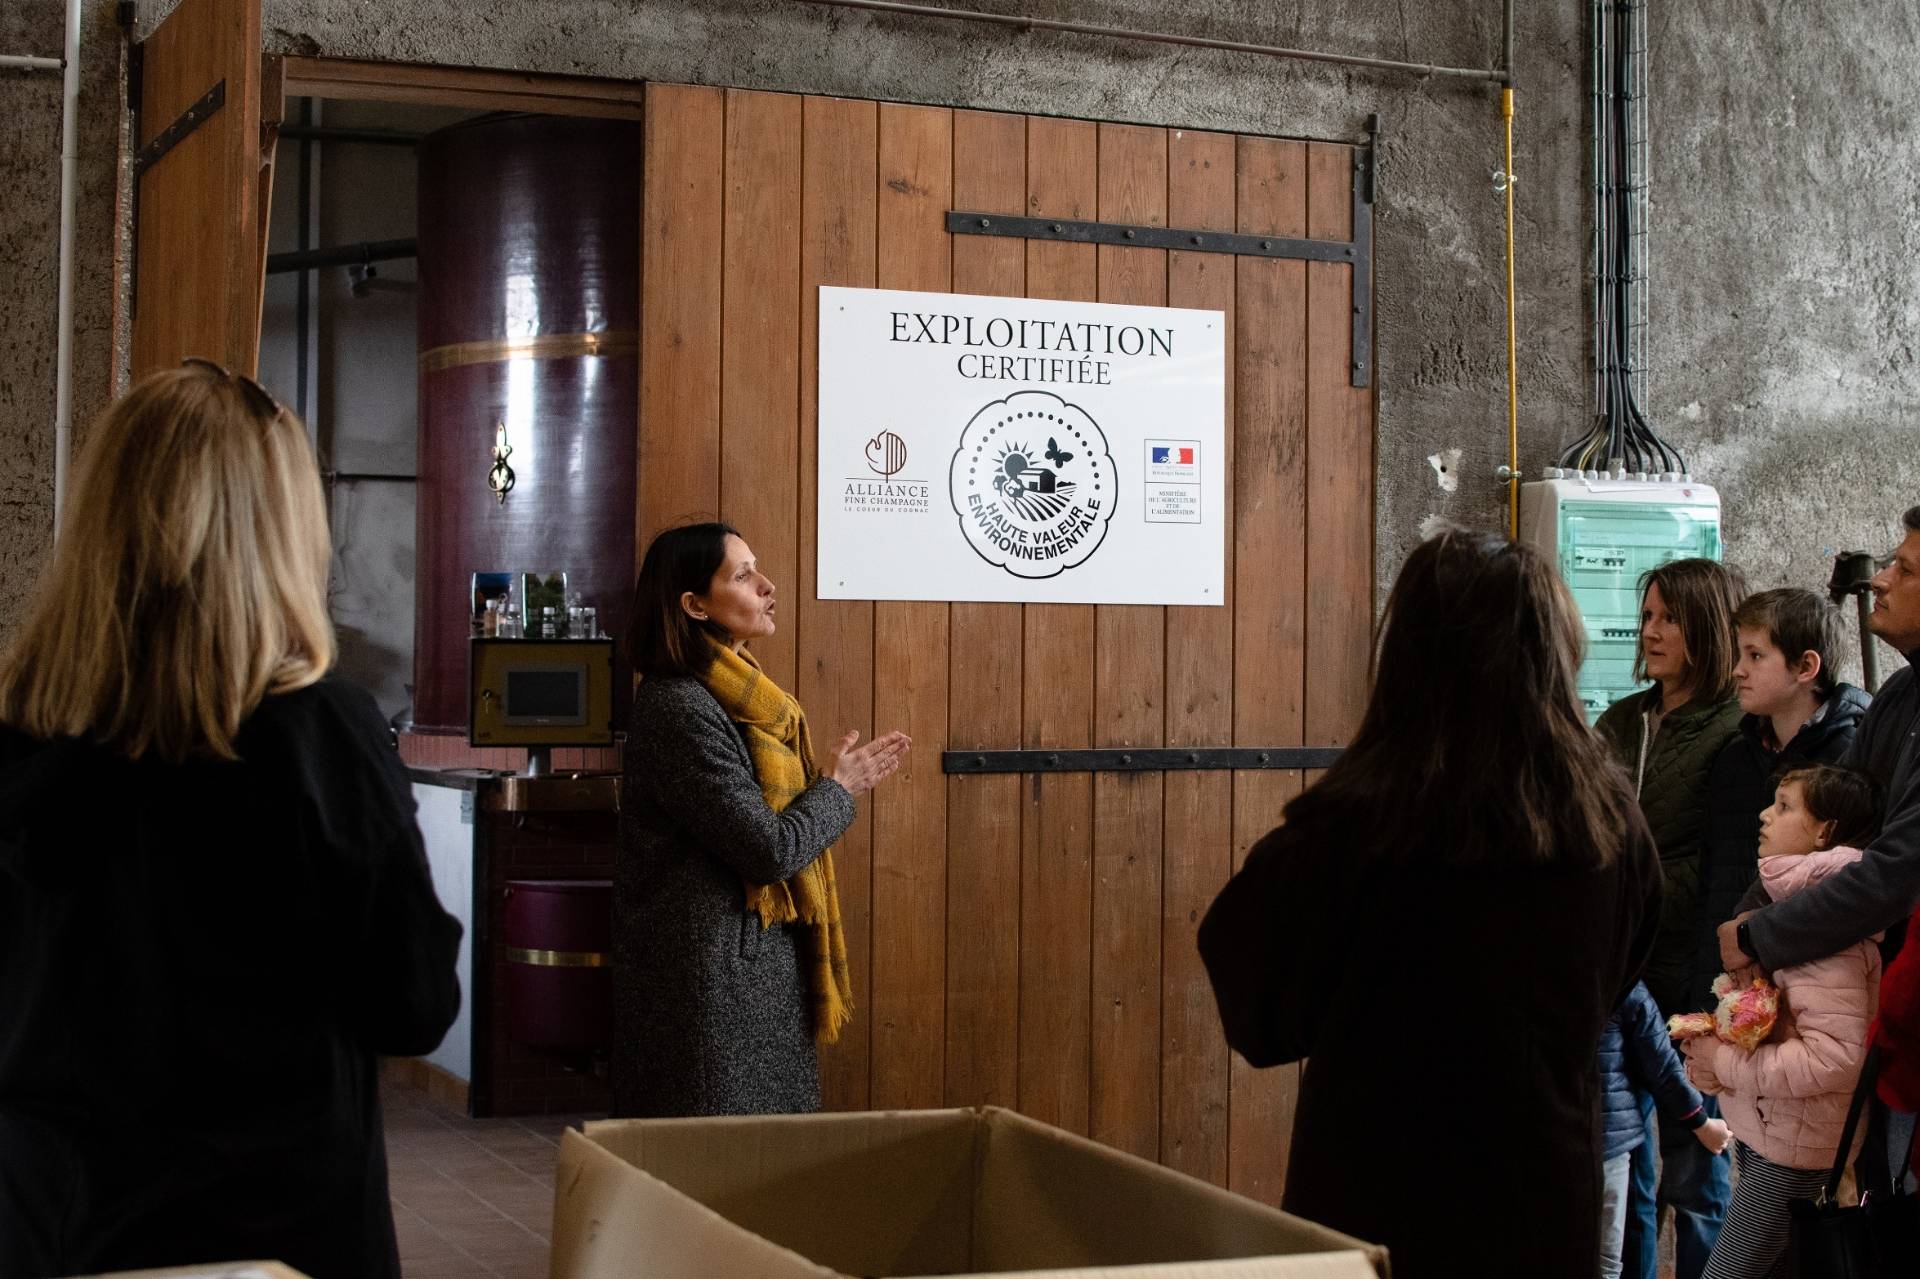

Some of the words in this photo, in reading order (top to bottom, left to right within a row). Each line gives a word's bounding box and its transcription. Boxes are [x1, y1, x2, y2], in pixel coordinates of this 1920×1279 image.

[889, 311, 1175, 358] EXPLOITATION
[957, 353, 1112, 385] CERTIFIÉE
[844, 496, 867, 504] FINE
[870, 497, 928, 507] CHAMPAGNE
[845, 483, 928, 497] ALLIANCE
[967, 493, 1101, 561] ENVIRONNEMENTALE
[985, 502, 1029, 543] HAUTE
[1032, 505, 1084, 545] VALEUR
